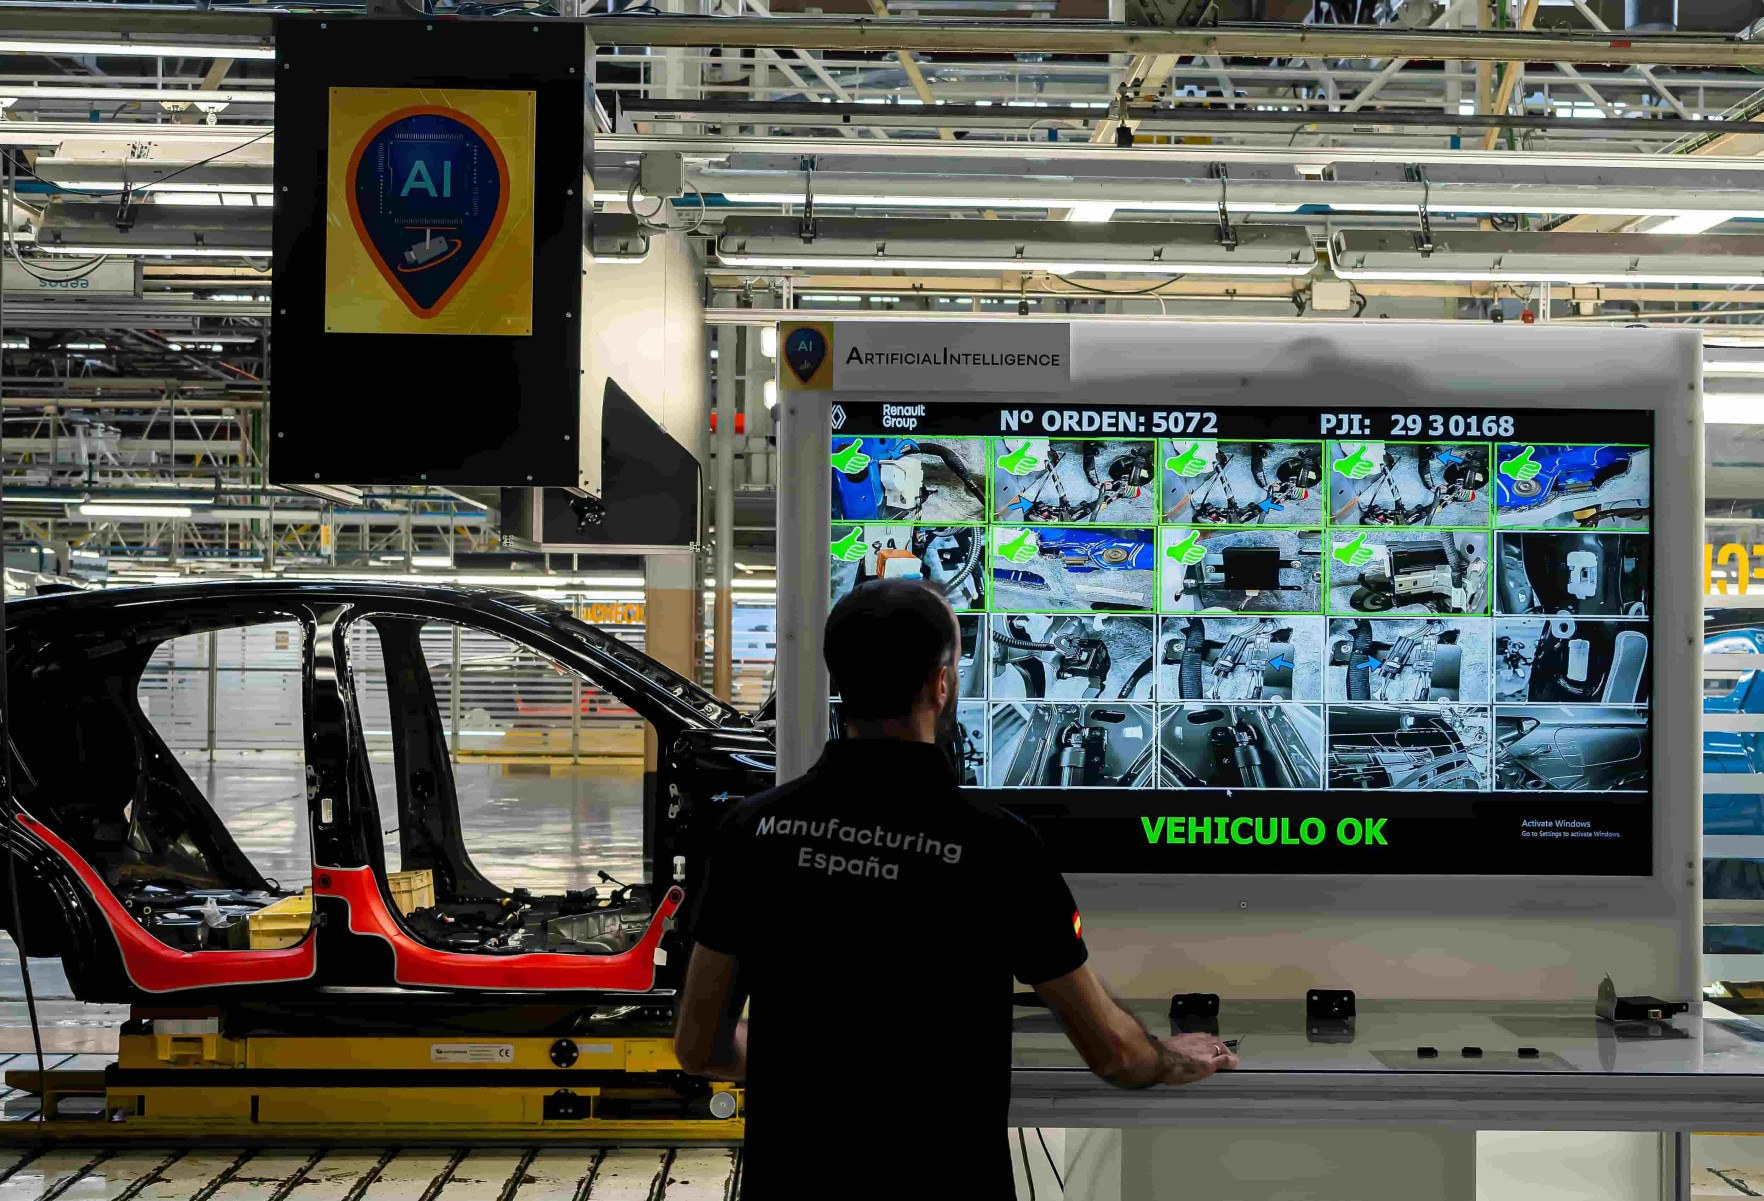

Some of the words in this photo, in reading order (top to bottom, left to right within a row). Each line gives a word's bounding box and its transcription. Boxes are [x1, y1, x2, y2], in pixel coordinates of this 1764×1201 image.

[400, 160, 452, 198] AI
[797, 340, 813, 352] AI
[883, 404, 926, 417] Renault
[1041, 410, 1145, 433] ORDEN:
[1151, 411, 1219, 433] 5072
[883, 416, 918, 431] Group
[1320, 413, 1371, 436] PJI:
[1140, 816, 1326, 845] VEHICULO
[1336, 817, 1389, 846] OK
[1521, 819, 1553, 828] Activate
[1554, 819, 1591, 828] Windows
[1539, 830, 1562, 839] Settings
[756, 815, 963, 864] Manufacturing
[798, 846, 900, 880] España
